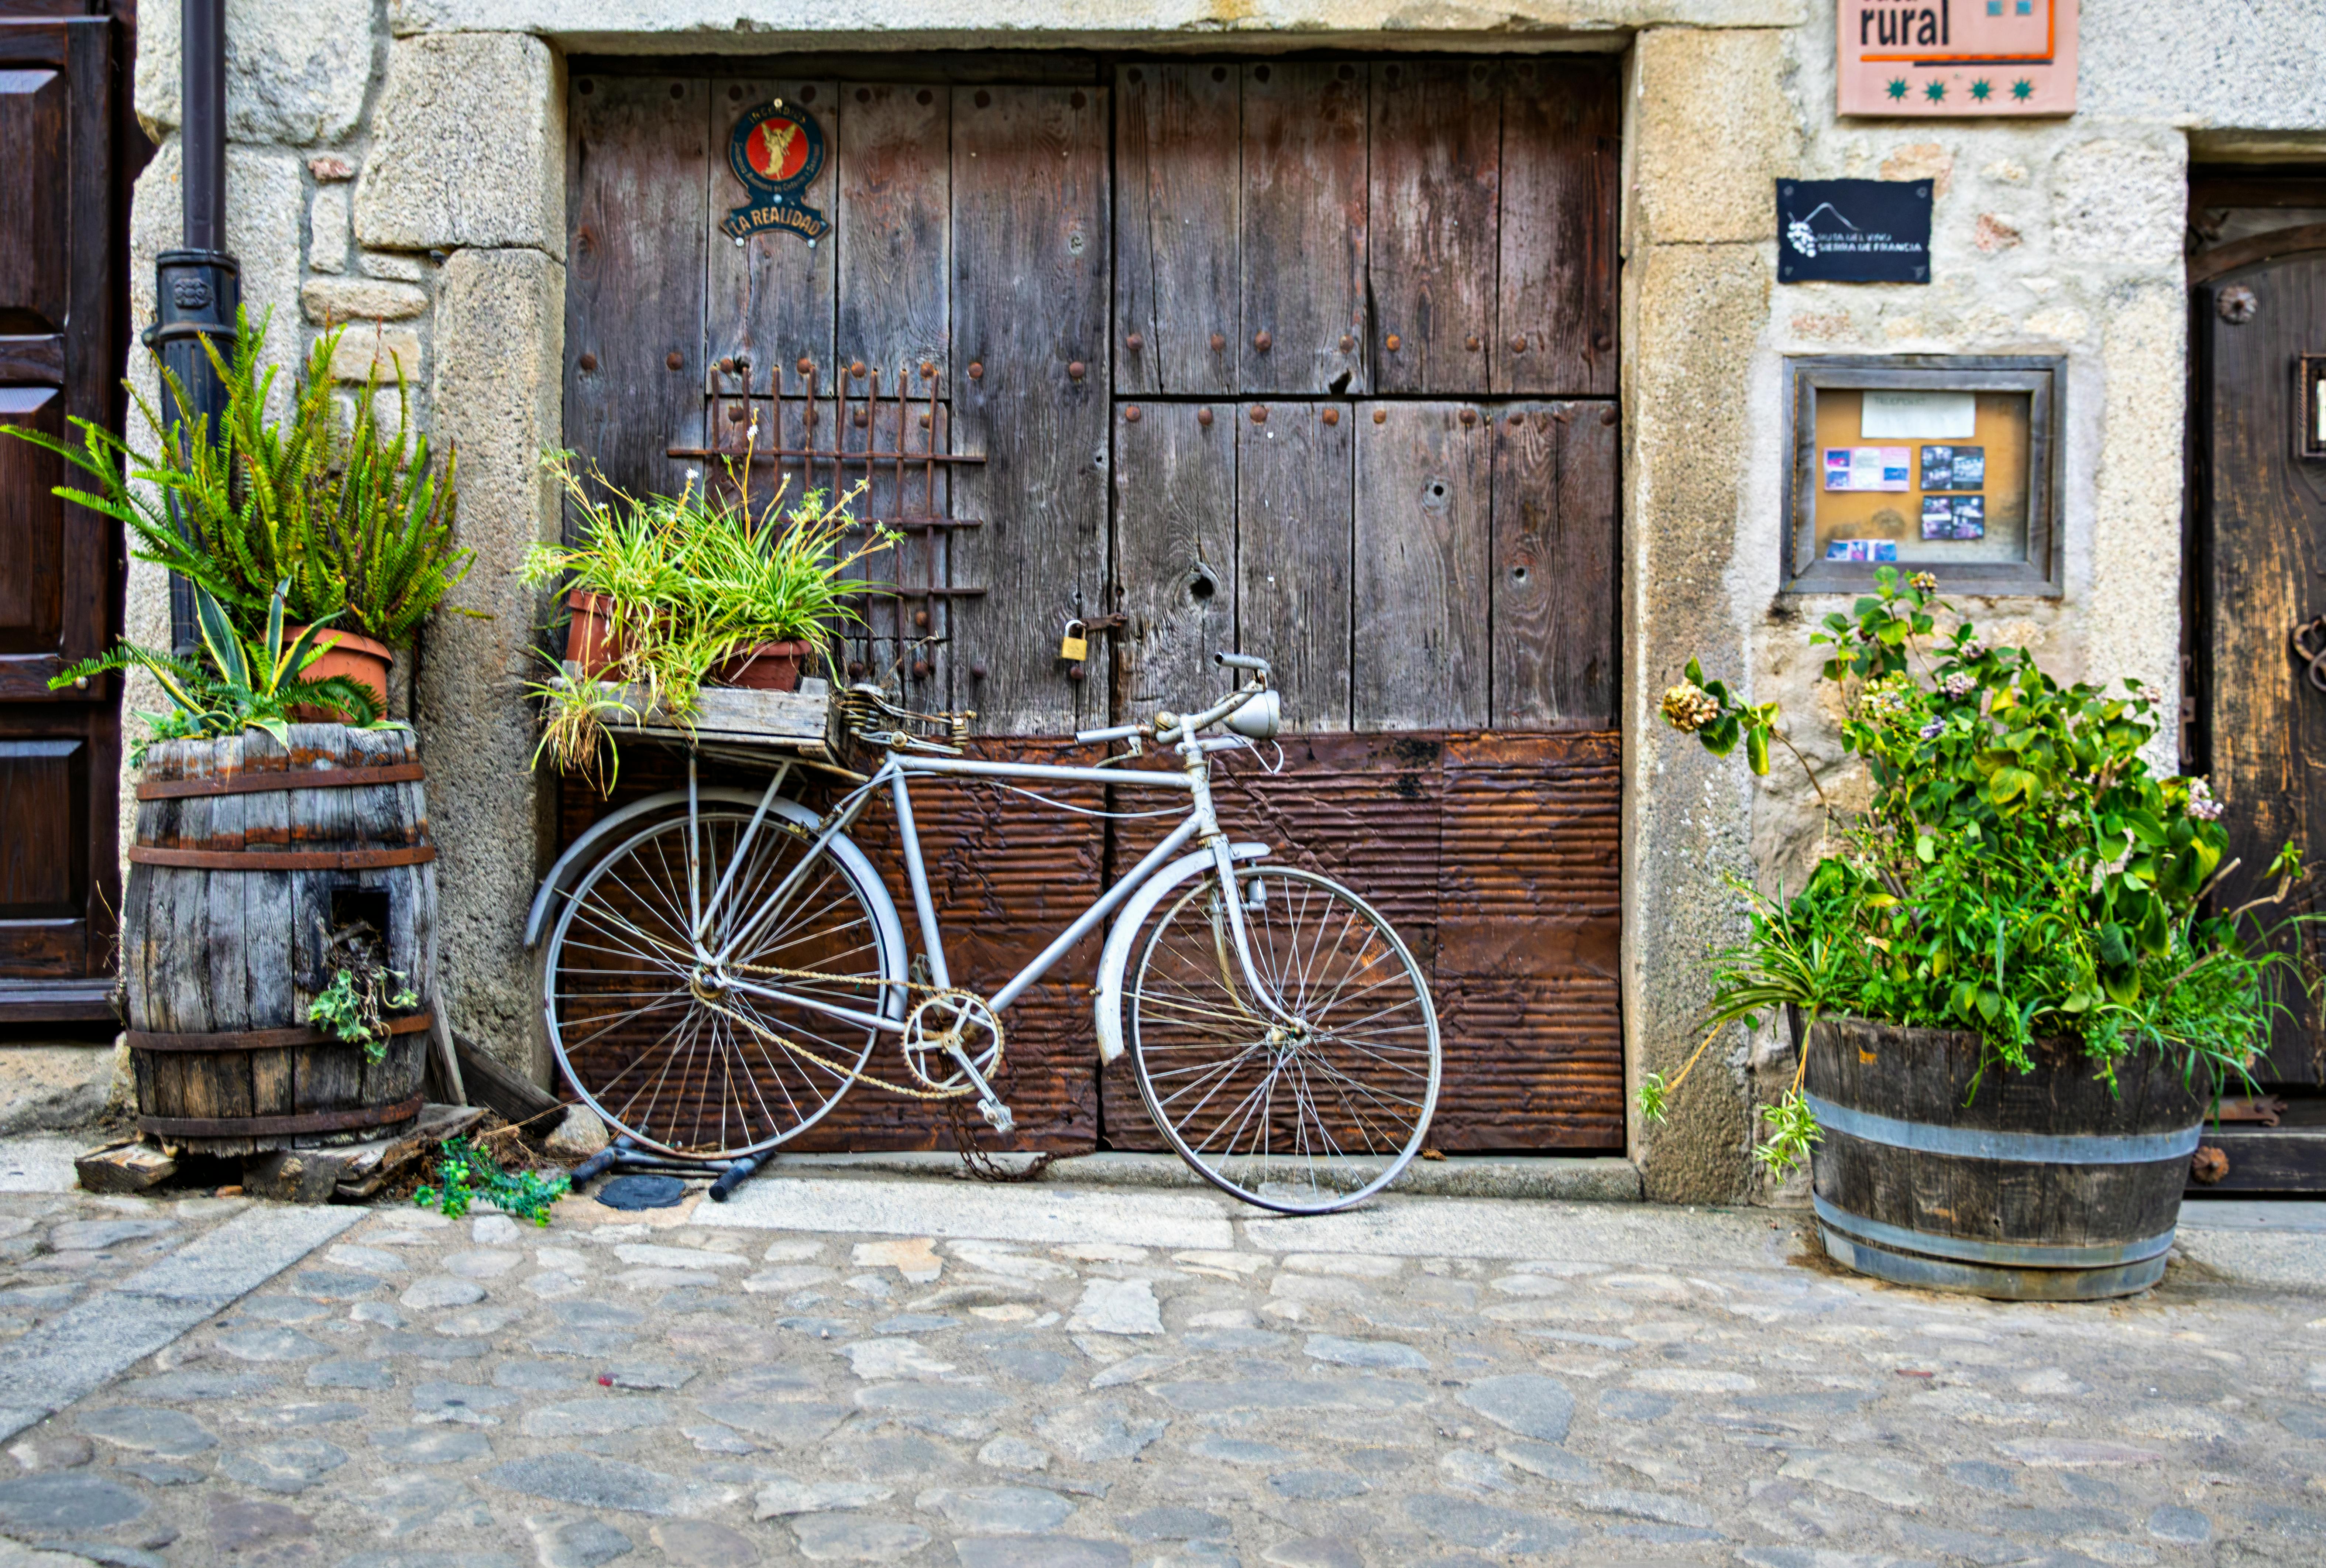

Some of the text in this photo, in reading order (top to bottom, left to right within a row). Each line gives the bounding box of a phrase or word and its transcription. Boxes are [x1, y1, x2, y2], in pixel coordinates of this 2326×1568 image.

[1861, 0, 1948, 45] rural
[731, 206, 820, 235] LA REALIDAD
[1873, 242, 1922, 252] FRANCIA
